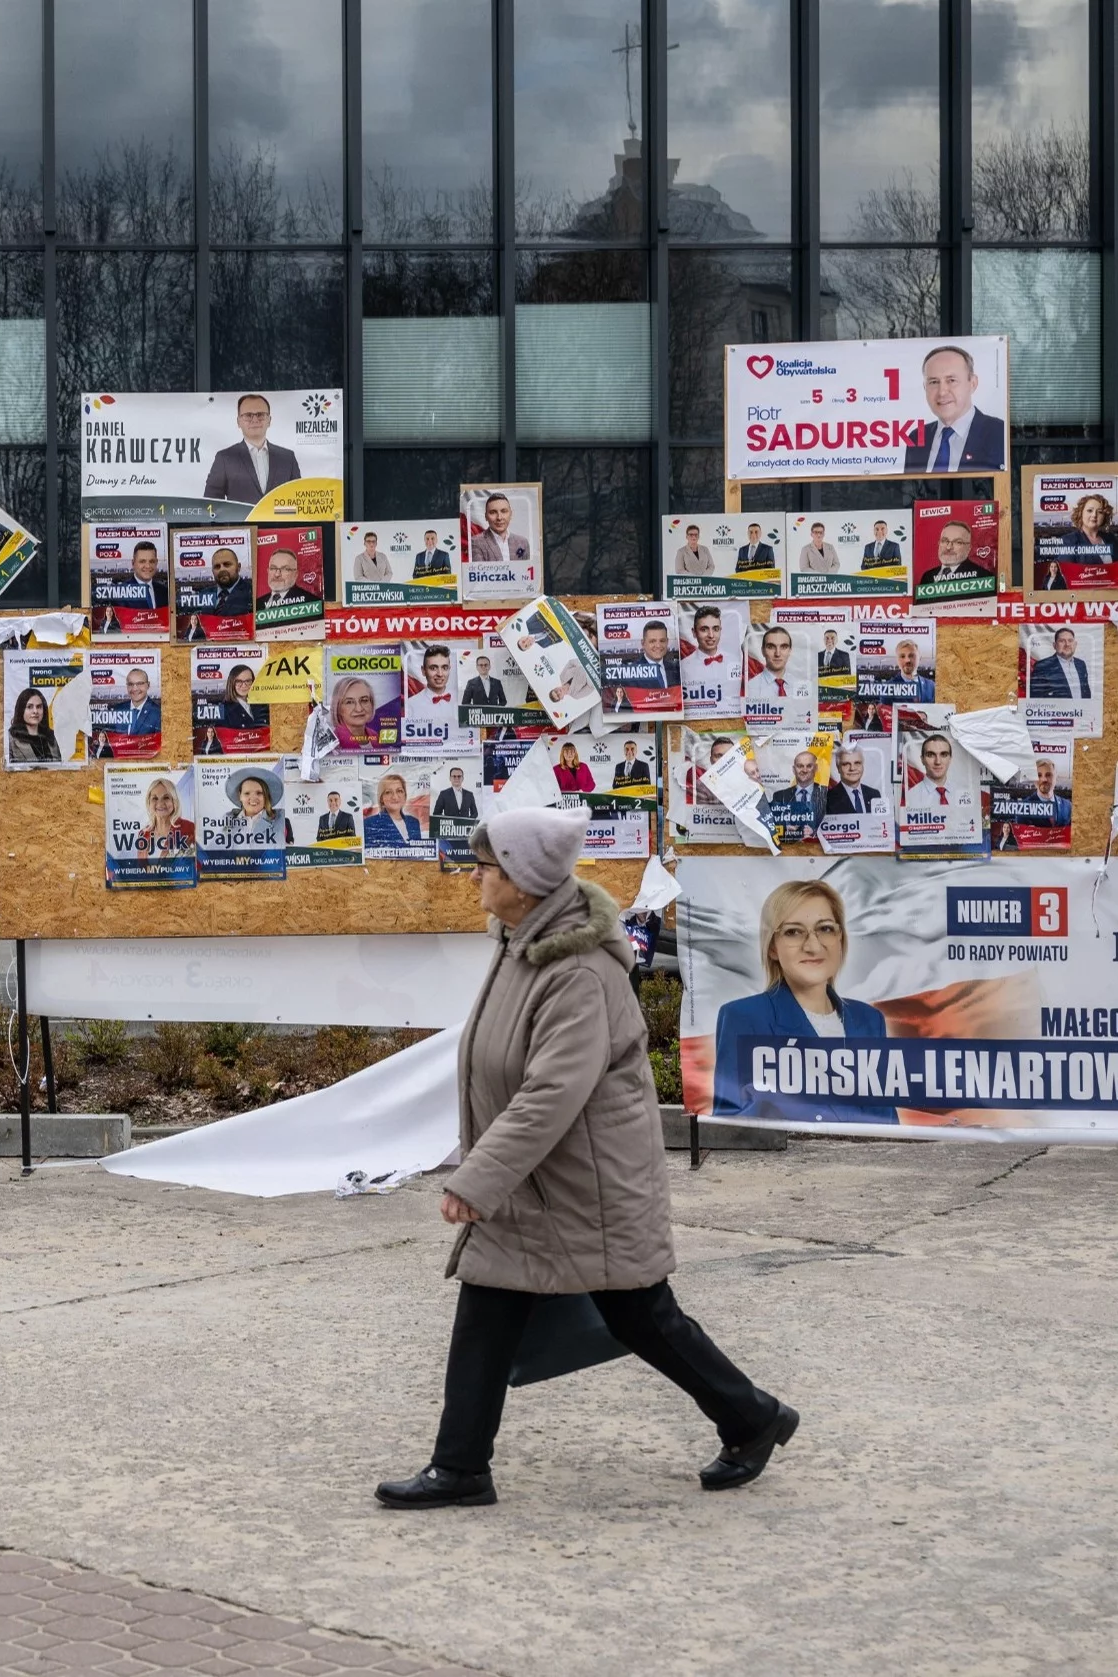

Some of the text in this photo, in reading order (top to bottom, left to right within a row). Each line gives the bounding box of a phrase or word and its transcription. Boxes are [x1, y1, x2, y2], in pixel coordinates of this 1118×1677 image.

[776, 360, 812, 368] Koalicja
[776, 367, 836, 376] Obywatelska
[812, 369, 899, 403] 5 3 1
[748, 406, 781, 420] Piotr
[86, 422, 125, 436] DANIEL
[747, 419, 925, 451] SADURSKI
[86, 438, 200, 463] KRAWCZYK
[748, 458, 790, 467] kandydat
[807, 458, 829, 466] Rady
[865, 456, 897, 465] Puławy
[86, 474, 118, 487] Dumny
[130, 476, 156, 485] Puław
[296, 490, 333, 498] KANDYDAT
[86, 508, 111, 516] OKRĘG
[160, 505, 165, 514] 1
[298, 506, 333, 514] PUŁAWY
[922, 508, 949, 516] LEWICA
[469, 571, 515, 582] Bińczak
[528, 567, 534, 580] 1
[96, 586, 146, 599] SZYMAŃSKI
[674, 584, 726, 595] BŁASZCZYŃSKA
[798, 582, 851, 593] BŁASZCZYŃSKA
[918, 580, 992, 595] KOWALCZYK
[181, 594, 213, 606] PYTLAK
[352, 590, 404, 601] BŁASZCZYŃSKA
[266, 656, 310, 677] TAK
[336, 657, 398, 670] GORGOL
[606, 666, 657, 679] SZYMAŃSKI
[858, 683, 916, 696] ZAKRZEWSKI
[197, 706, 220, 719] ŁATA
[746, 704, 784, 714] Miller
[1026, 709, 1082, 718] Orkiszewski
[468, 713, 514, 724] KRAWCZYK
[382, 730, 395, 740] 12
[406, 723, 448, 739] Sulej
[635, 800, 641, 809] 2
[994, 801, 1053, 815] ZAKRZEWSKI
[203, 817, 248, 827] Paulina
[907, 813, 946, 823] Miller
[113, 819, 140, 830] Ewa
[821, 821, 859, 831] Gorgol
[586, 827, 615, 837] orgol
[113, 832, 188, 855] Wójcik
[203, 829, 277, 848] Pajórek
[957, 893, 1060, 932] NUMER 3
[948, 944, 1068, 961] DO RADY POWIATU
